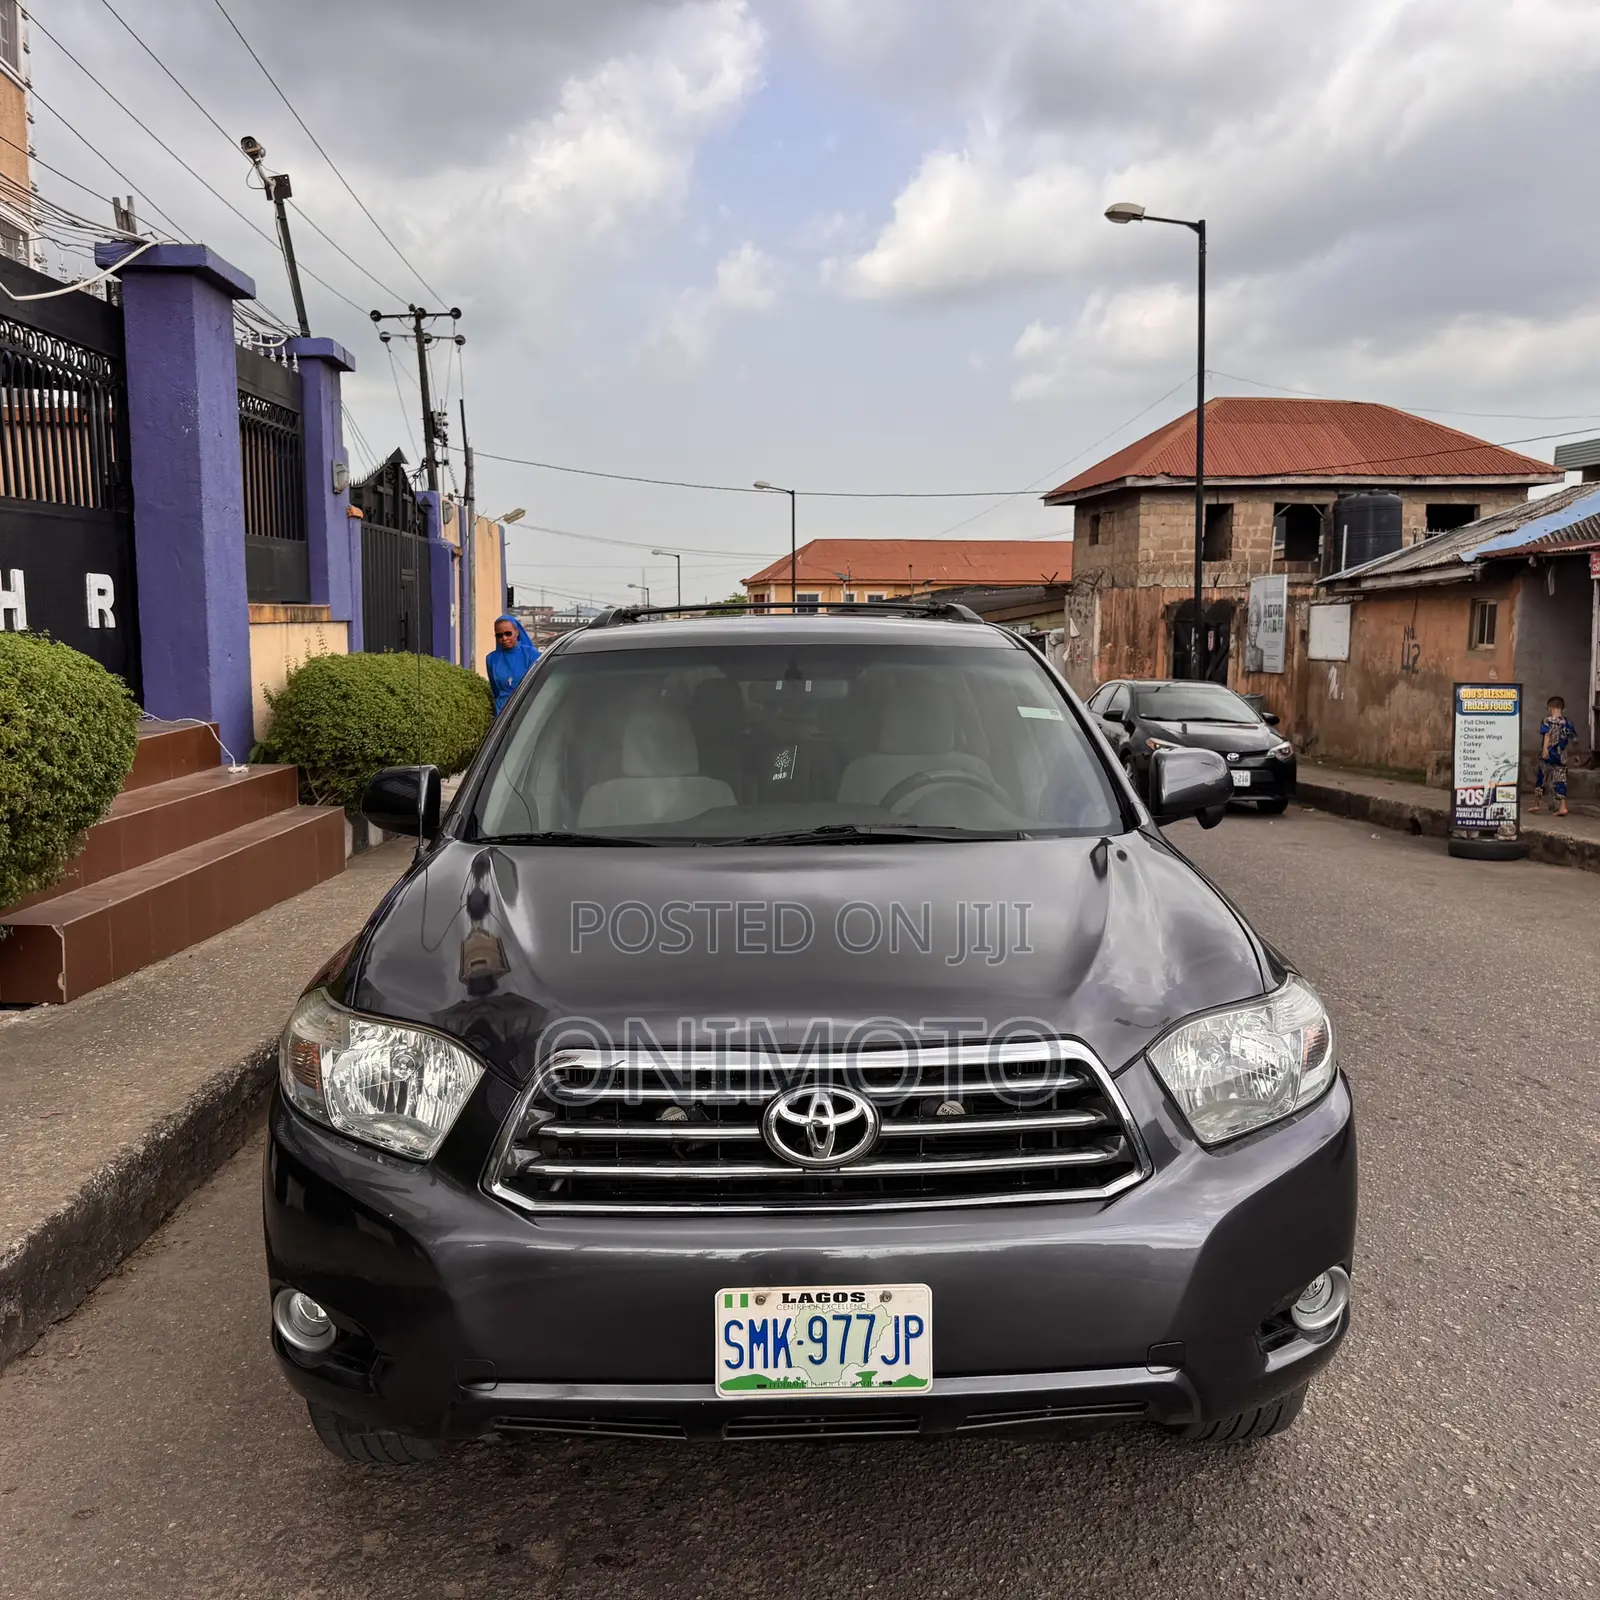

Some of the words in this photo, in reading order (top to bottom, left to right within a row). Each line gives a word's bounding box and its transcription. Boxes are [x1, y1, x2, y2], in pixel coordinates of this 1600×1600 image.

[86, 572, 117, 629] R
[1483, 688, 1517, 700] BLESSING
[1464, 701, 1489, 711] FROZEN
[1490, 701, 1513, 711] FOODS
[1456, 788, 1485, 806] POS
[781, 1292, 866, 1304] LAGOS
[776, 1303, 806, 1311] CENTRE
[808, 1303, 819, 1311] OF
[821, 1302, 871, 1310] EXCELLENCE
